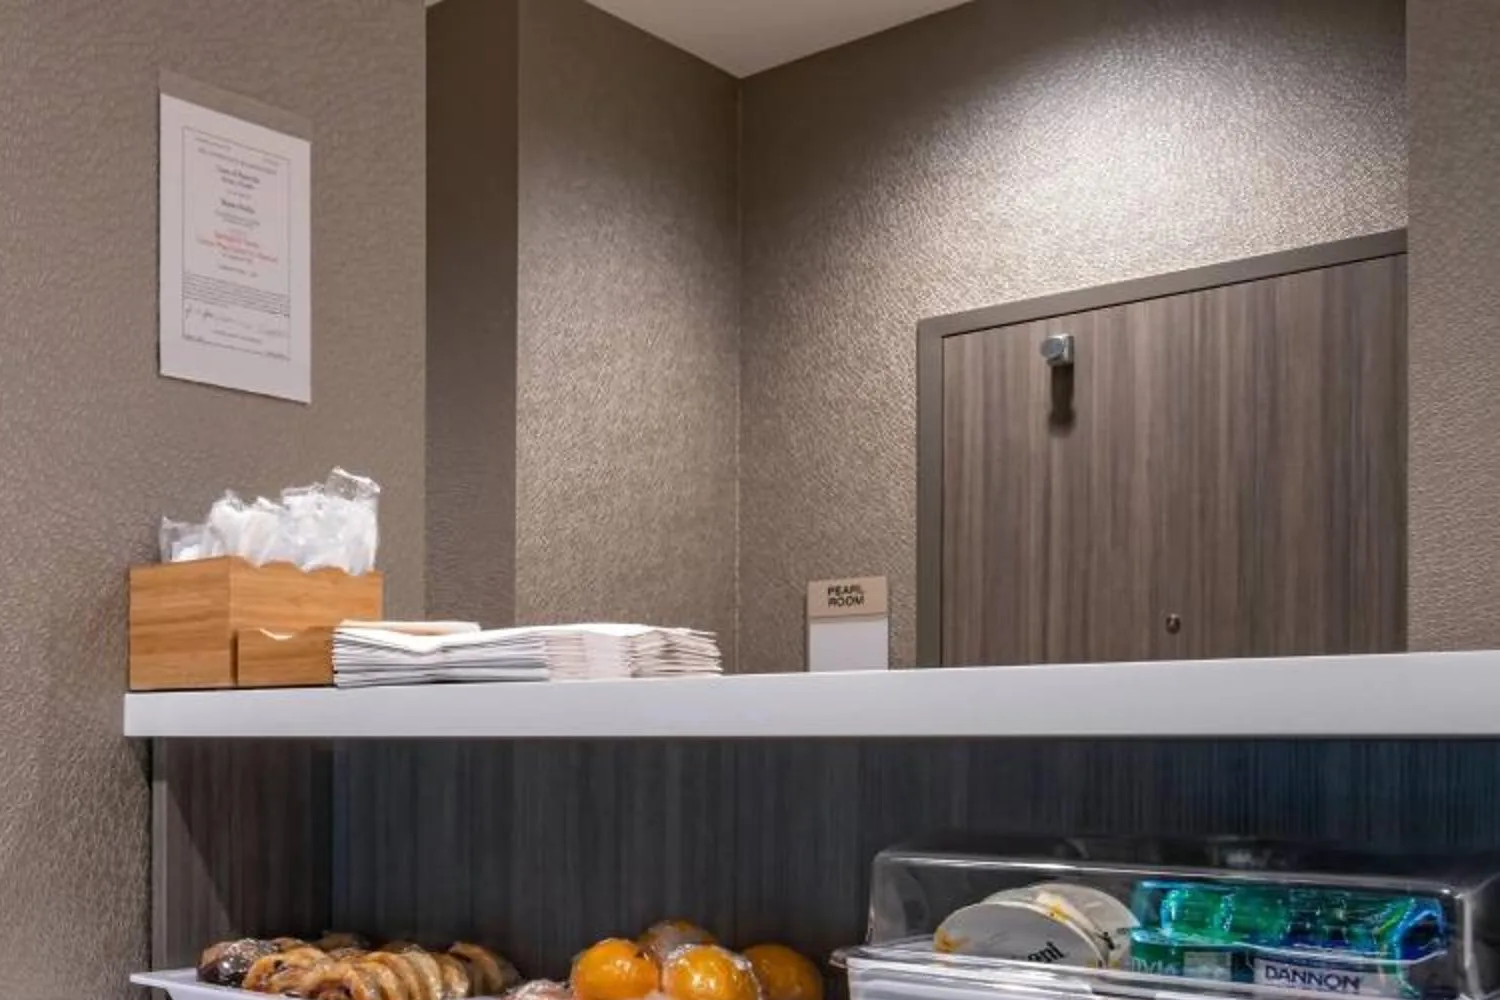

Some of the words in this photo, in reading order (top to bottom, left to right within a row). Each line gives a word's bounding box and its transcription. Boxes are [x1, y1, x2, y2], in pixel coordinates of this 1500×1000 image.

[827, 584, 865, 597] PEARL
[827, 595, 865, 608] ROOM
[1264, 965, 1361, 994] DANNON
